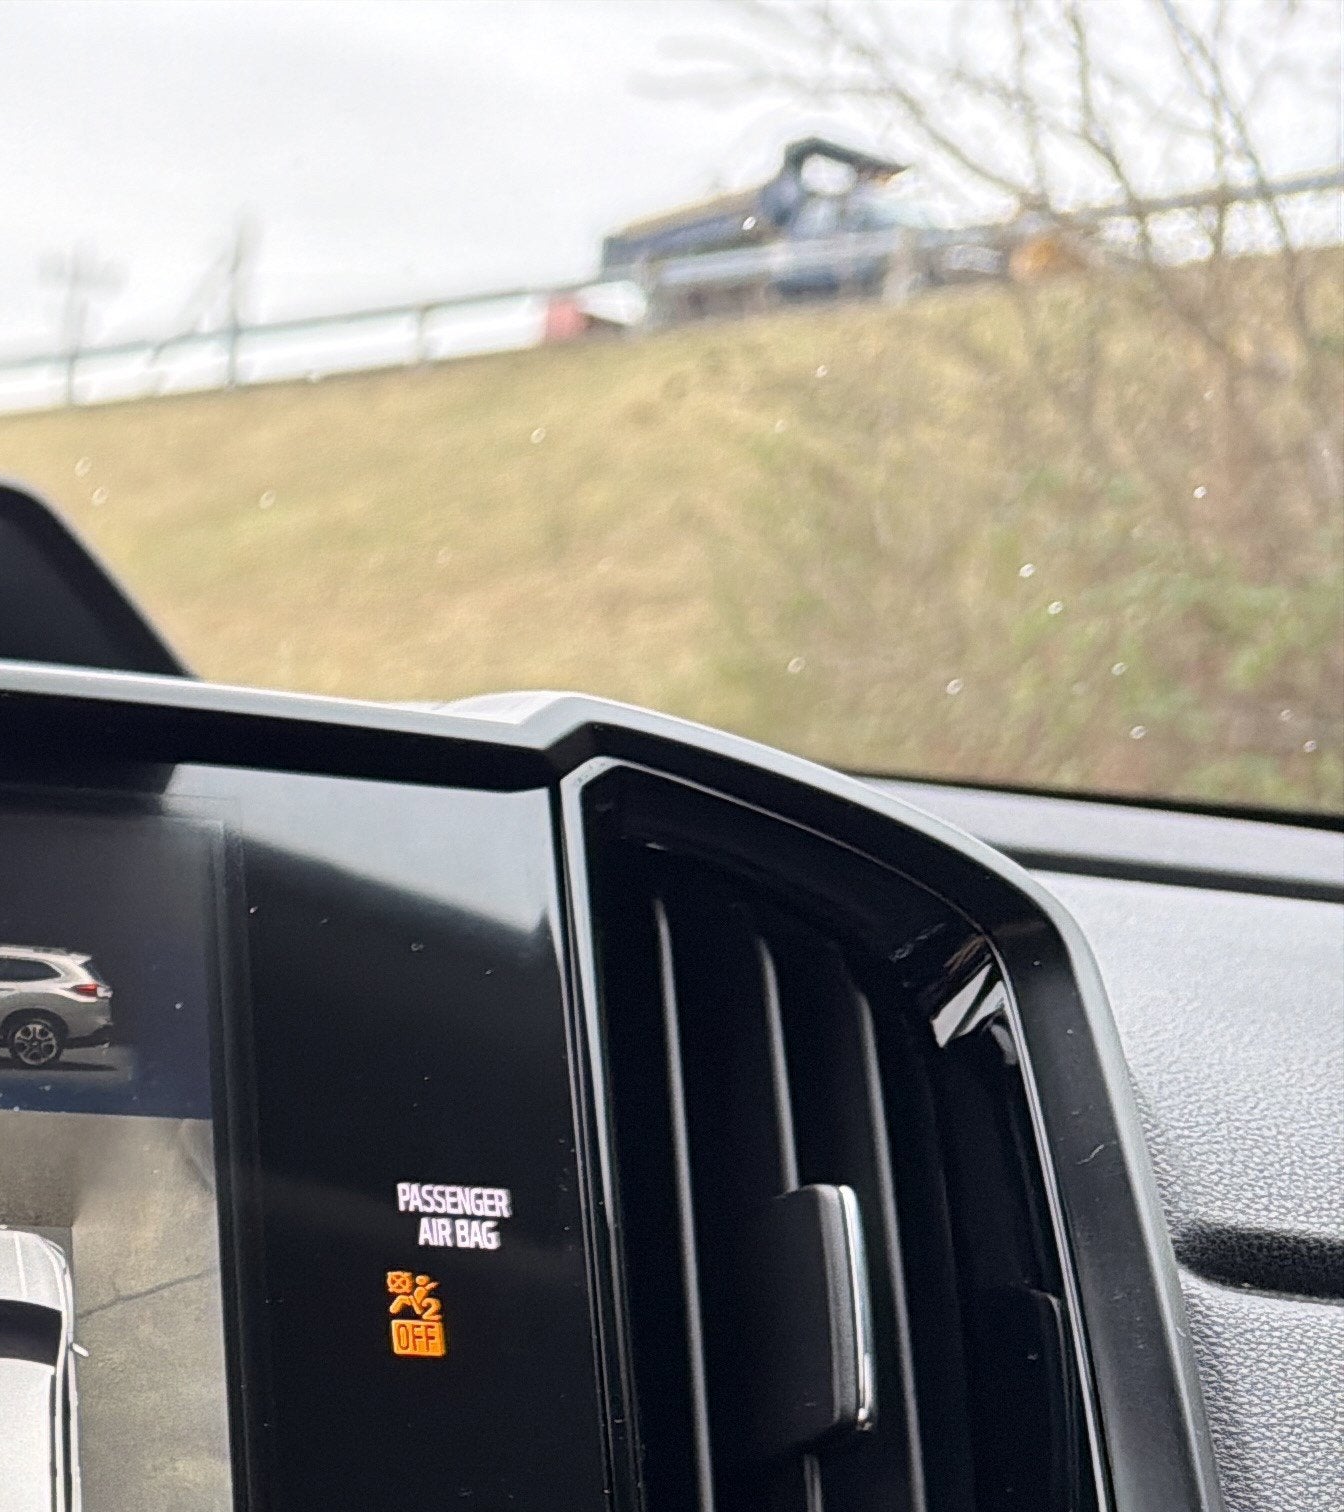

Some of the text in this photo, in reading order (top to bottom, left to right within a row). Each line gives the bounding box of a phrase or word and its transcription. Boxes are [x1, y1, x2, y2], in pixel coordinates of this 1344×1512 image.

[397, 1183, 510, 1217] PASSENGER
[419, 1217, 500, 1249] AIR BAG
[396, 1322, 436, 1352] OFF
